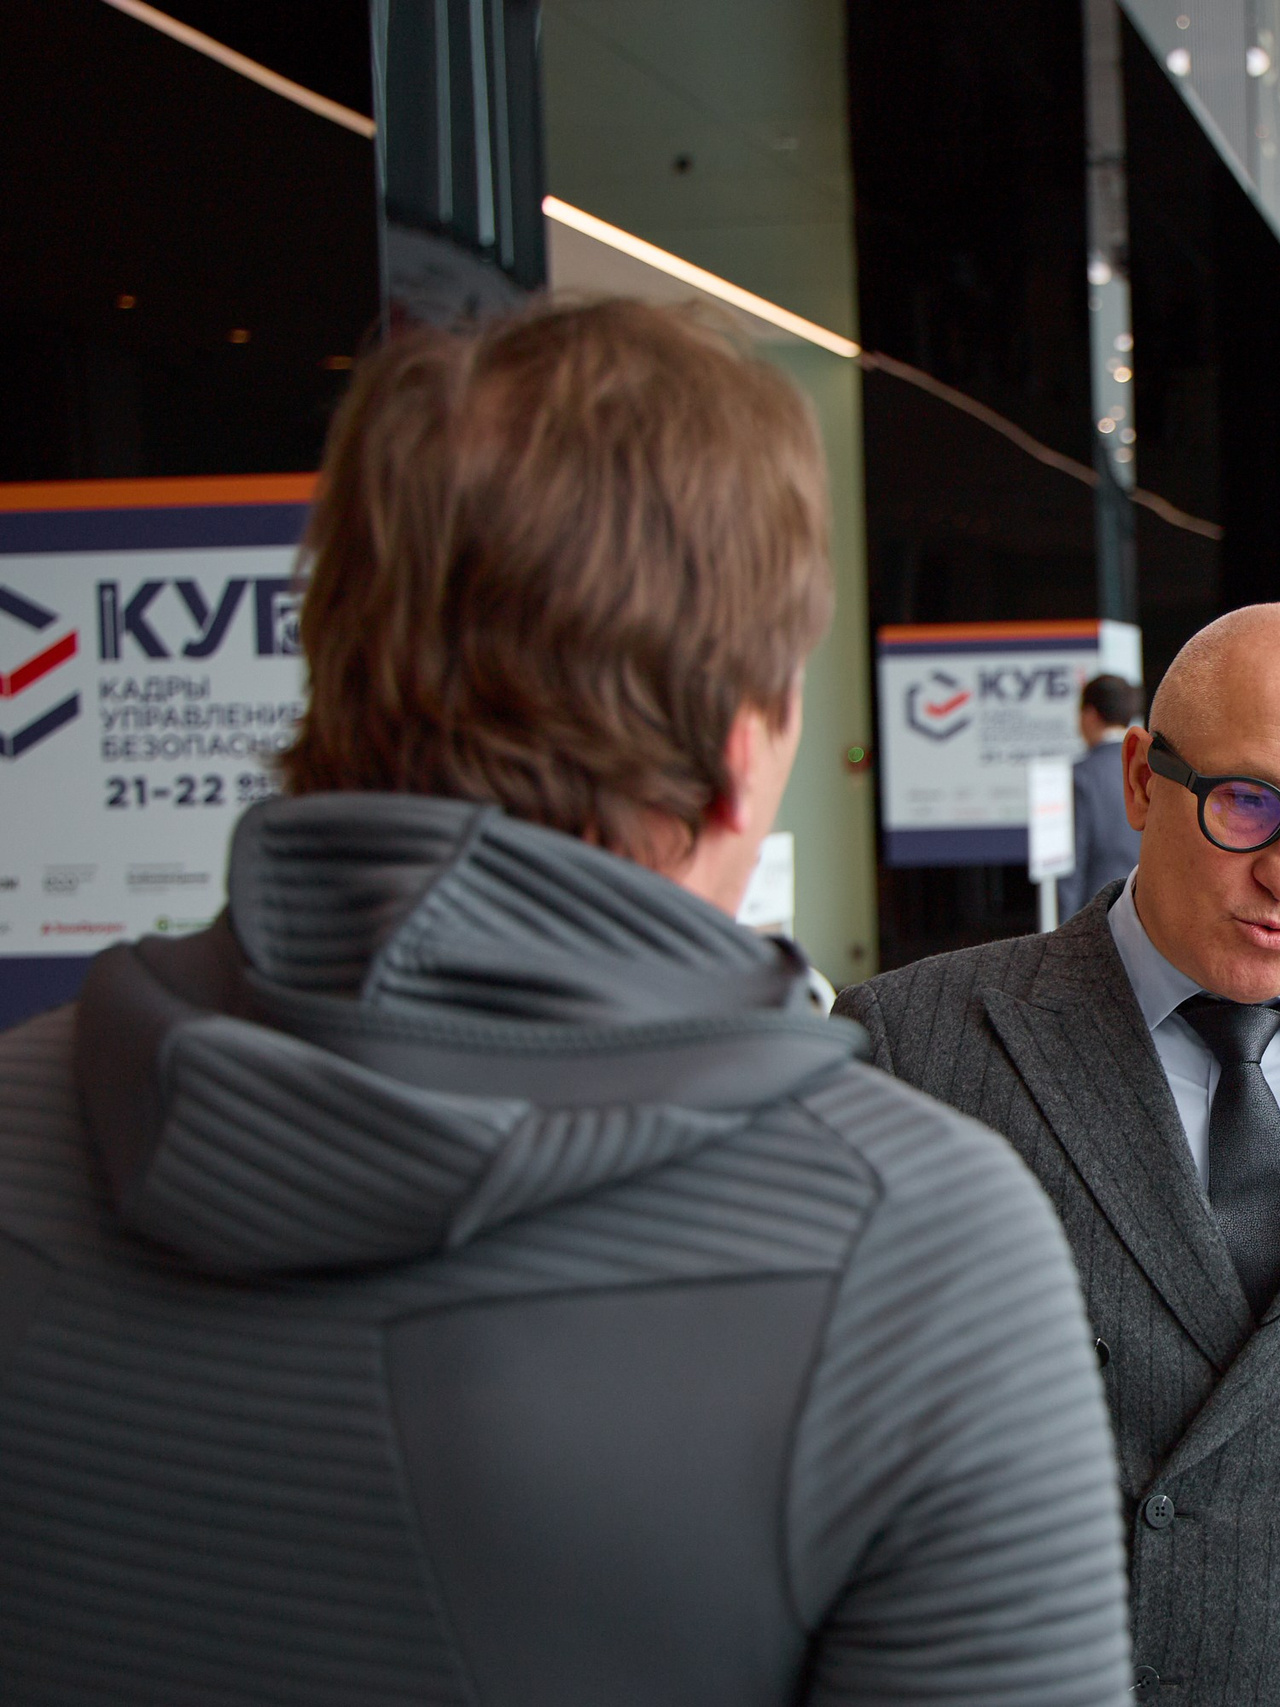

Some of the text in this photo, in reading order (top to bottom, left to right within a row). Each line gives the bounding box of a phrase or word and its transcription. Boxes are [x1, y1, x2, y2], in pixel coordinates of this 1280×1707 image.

[99, 676, 209, 701] КАДРЫ
[977, 666, 1071, 704] КУБ
[106, 774, 223, 808] 21-22
